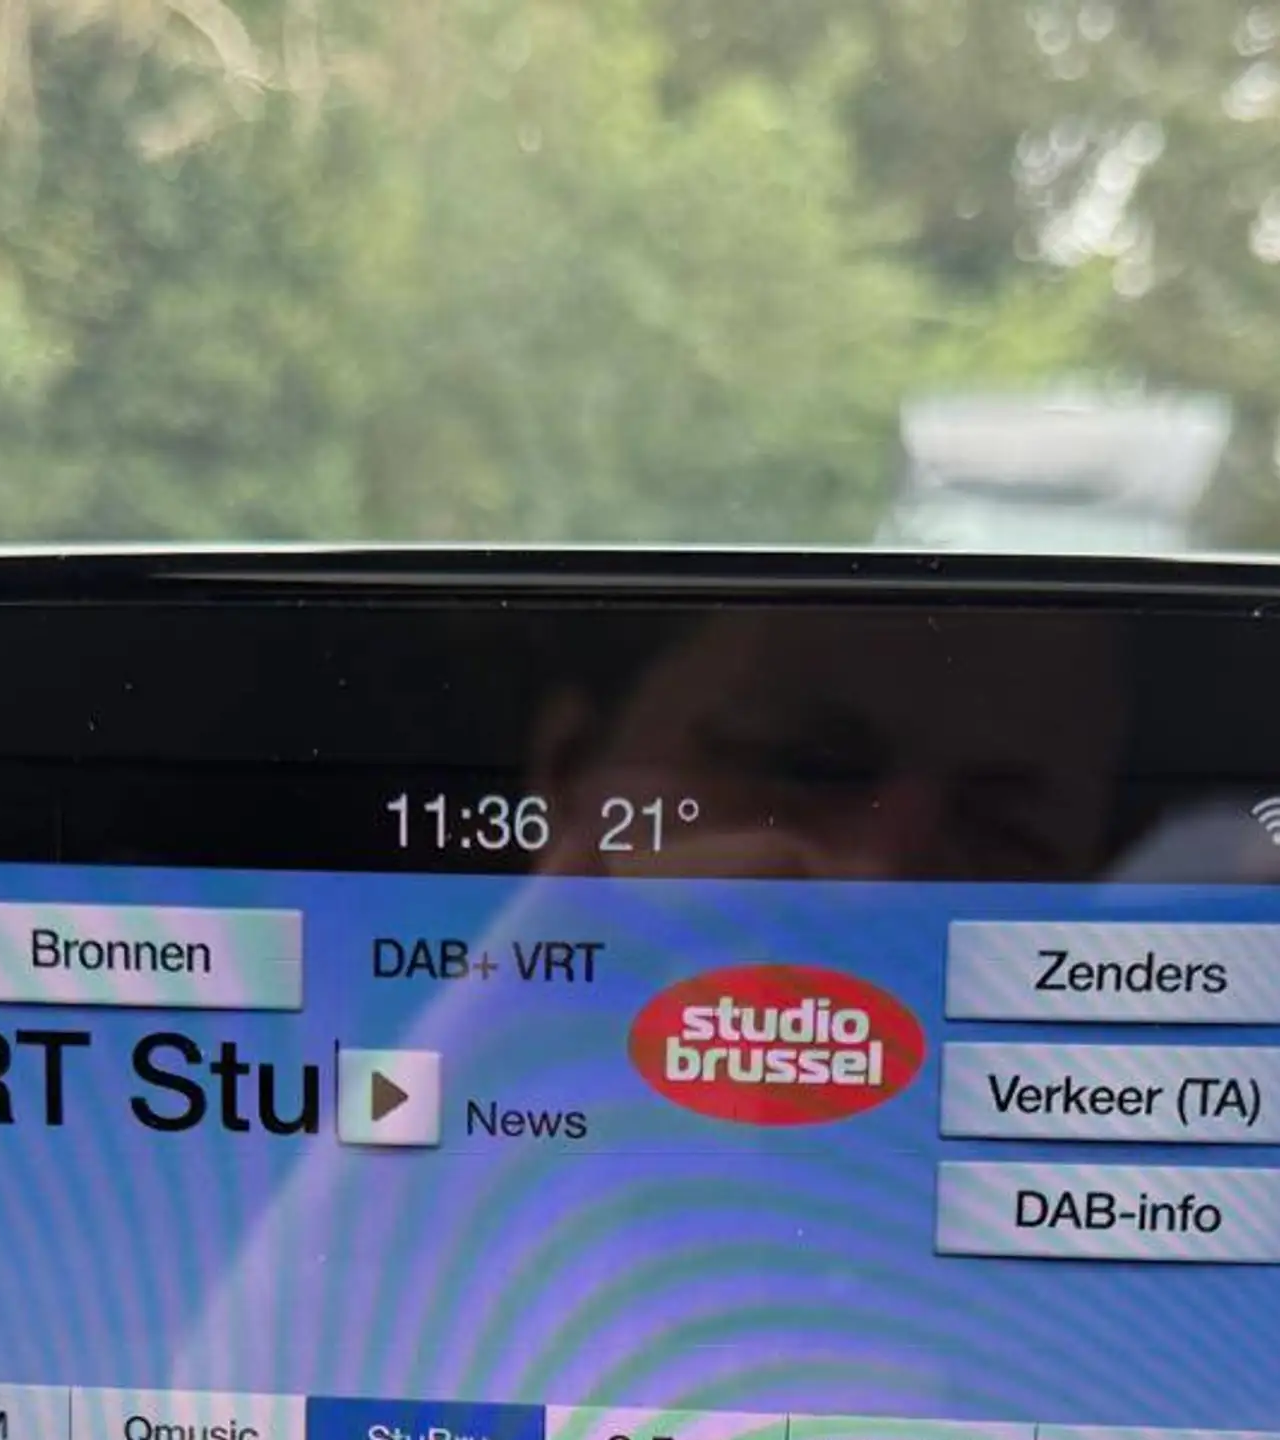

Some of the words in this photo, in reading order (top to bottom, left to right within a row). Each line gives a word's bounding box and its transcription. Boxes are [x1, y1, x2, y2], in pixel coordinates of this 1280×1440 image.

[385, 795, 550, 850] 11:36
[598, 797, 699, 852] 21°
[31, 929, 211, 974] Bronnen
[372, 937, 497, 980] DAB+
[512, 943, 605, 982] VRT
[1035, 950, 1228, 994] Zenders
[682, 997, 869, 1044] studio
[129, 1030, 340, 1136] Stu
[665, 1037, 883, 1086] brussel
[465, 1101, 587, 1140] News
[988, 1074, 1162, 1117] Verkeer
[1176, 1077, 1262, 1126] (TA)
[1015, 1190, 1222, 1234] DAB-info
